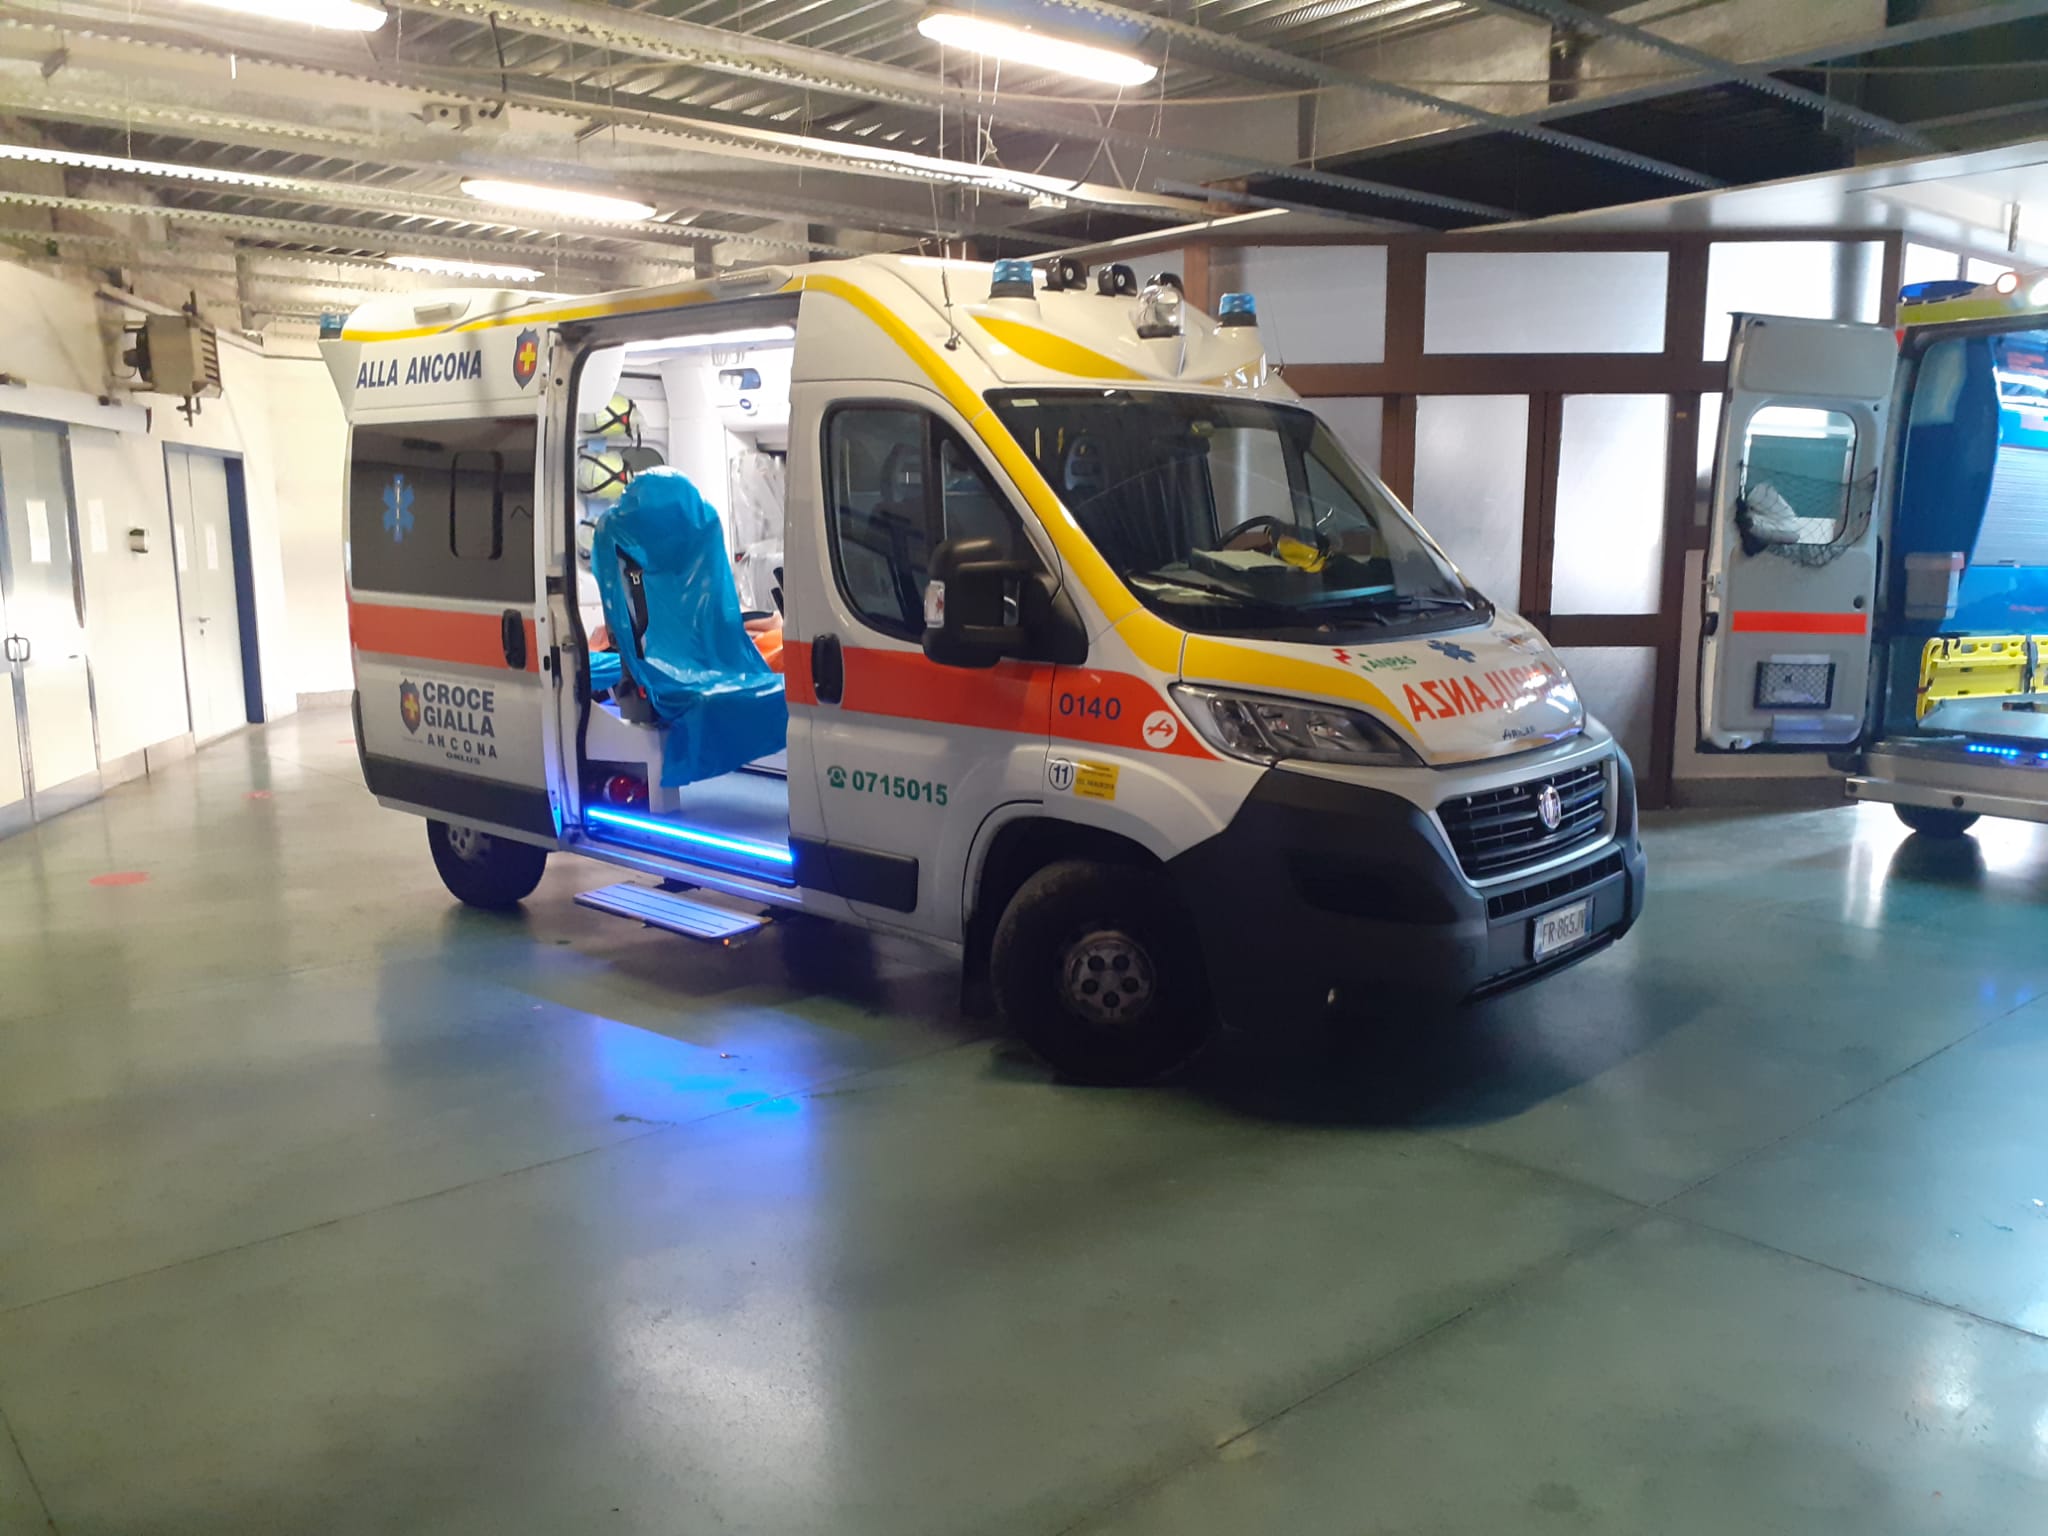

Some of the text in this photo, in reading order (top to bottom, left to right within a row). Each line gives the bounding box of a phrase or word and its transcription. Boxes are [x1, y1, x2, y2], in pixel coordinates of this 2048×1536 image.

[356, 349, 482, 389] ALLA ANCONA
[422, 681, 495, 713] CROCE
[1058, 692, 1121, 721] 0140
[423, 705, 495, 738] GIALLA
[427, 732, 498, 759] ANCONA
[851, 769, 949, 806] 0715015
[1053, 764, 1069, 785] 11
